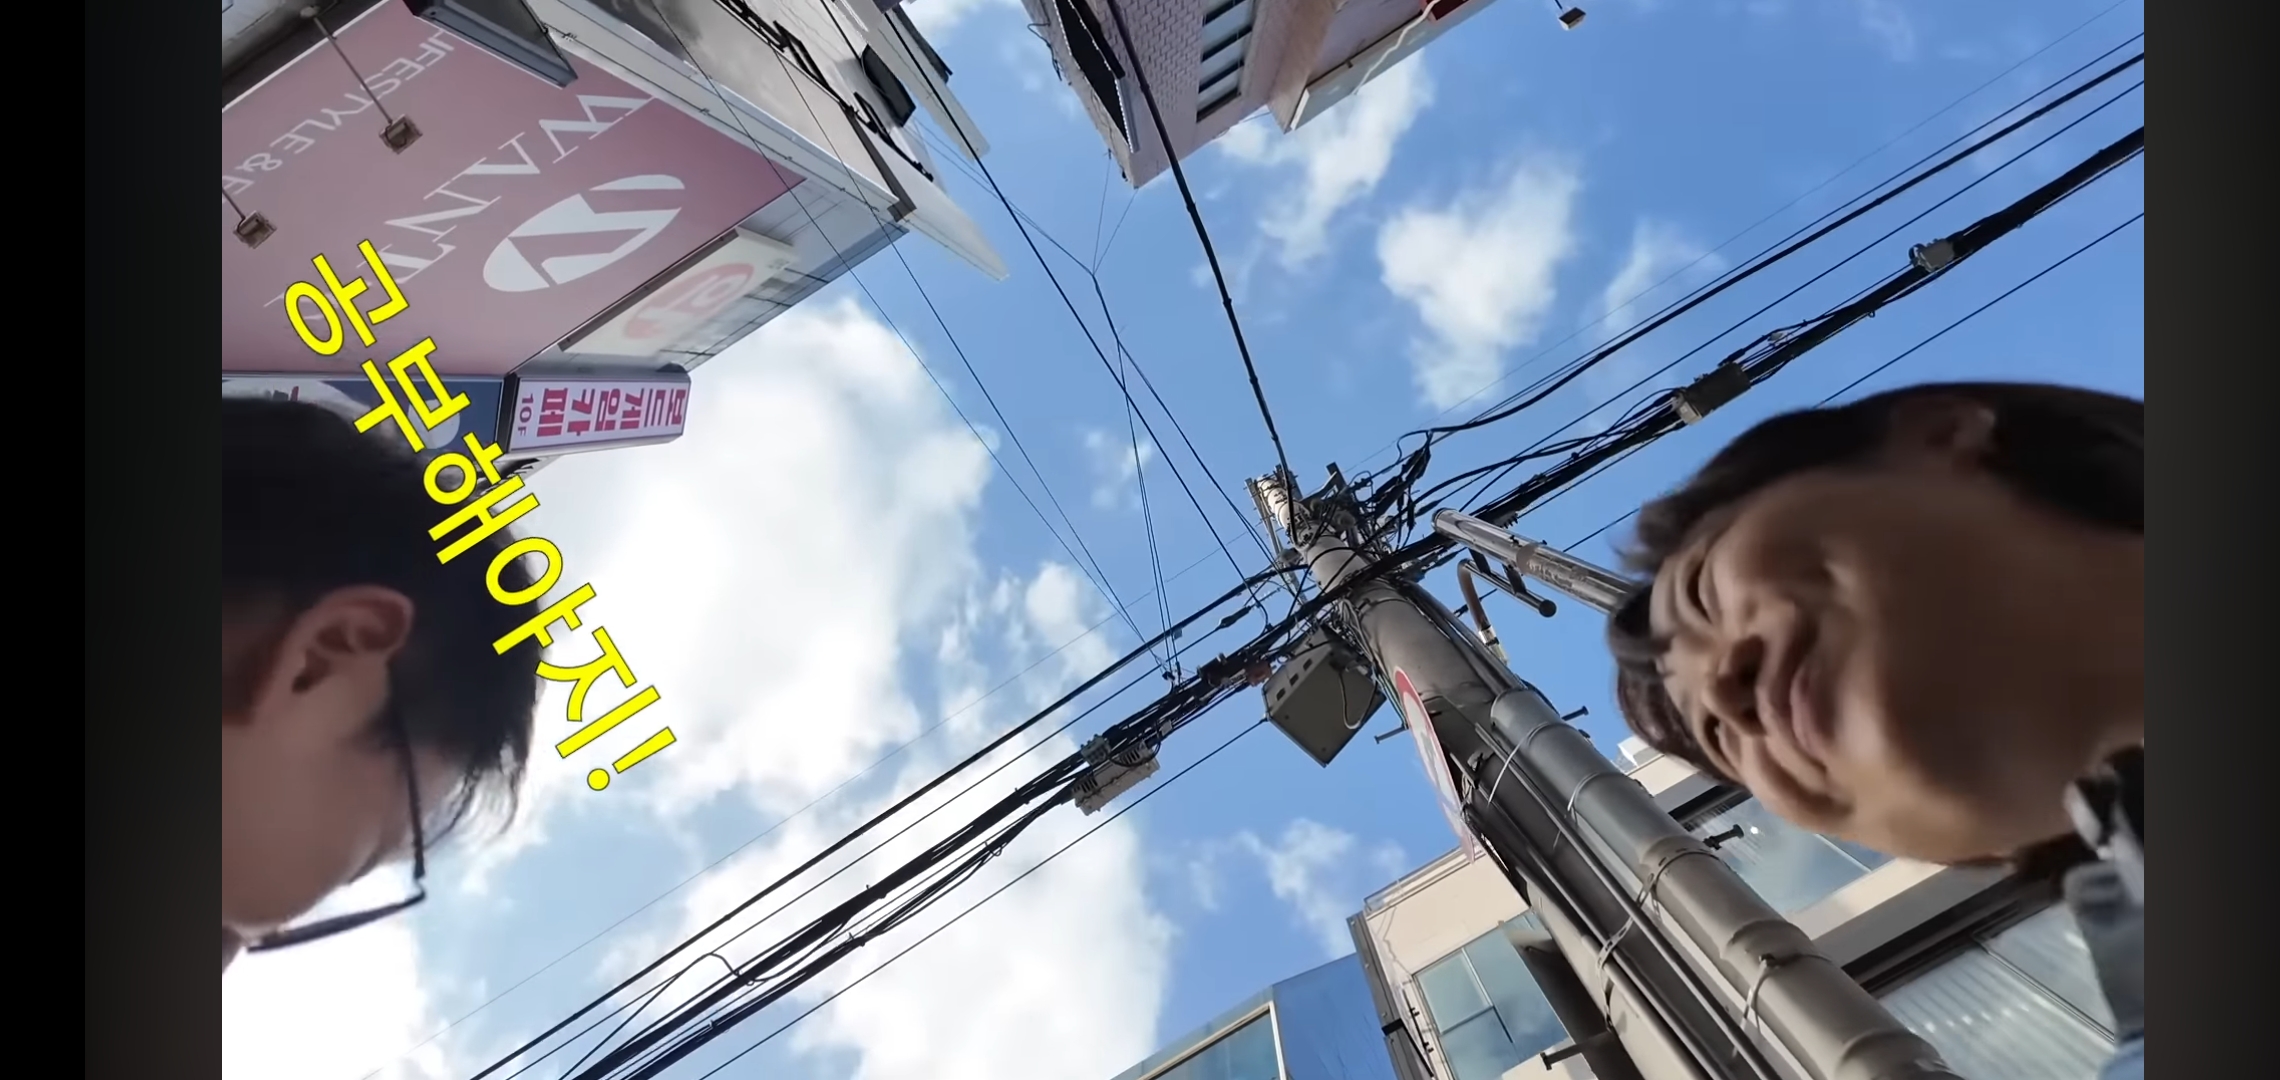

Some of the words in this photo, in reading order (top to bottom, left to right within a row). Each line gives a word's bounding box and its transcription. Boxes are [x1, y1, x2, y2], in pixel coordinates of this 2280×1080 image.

[234, 152, 284, 173] &
[518, 393, 534, 437] 10F
[536, 388, 687, 437] 보드게임카페
